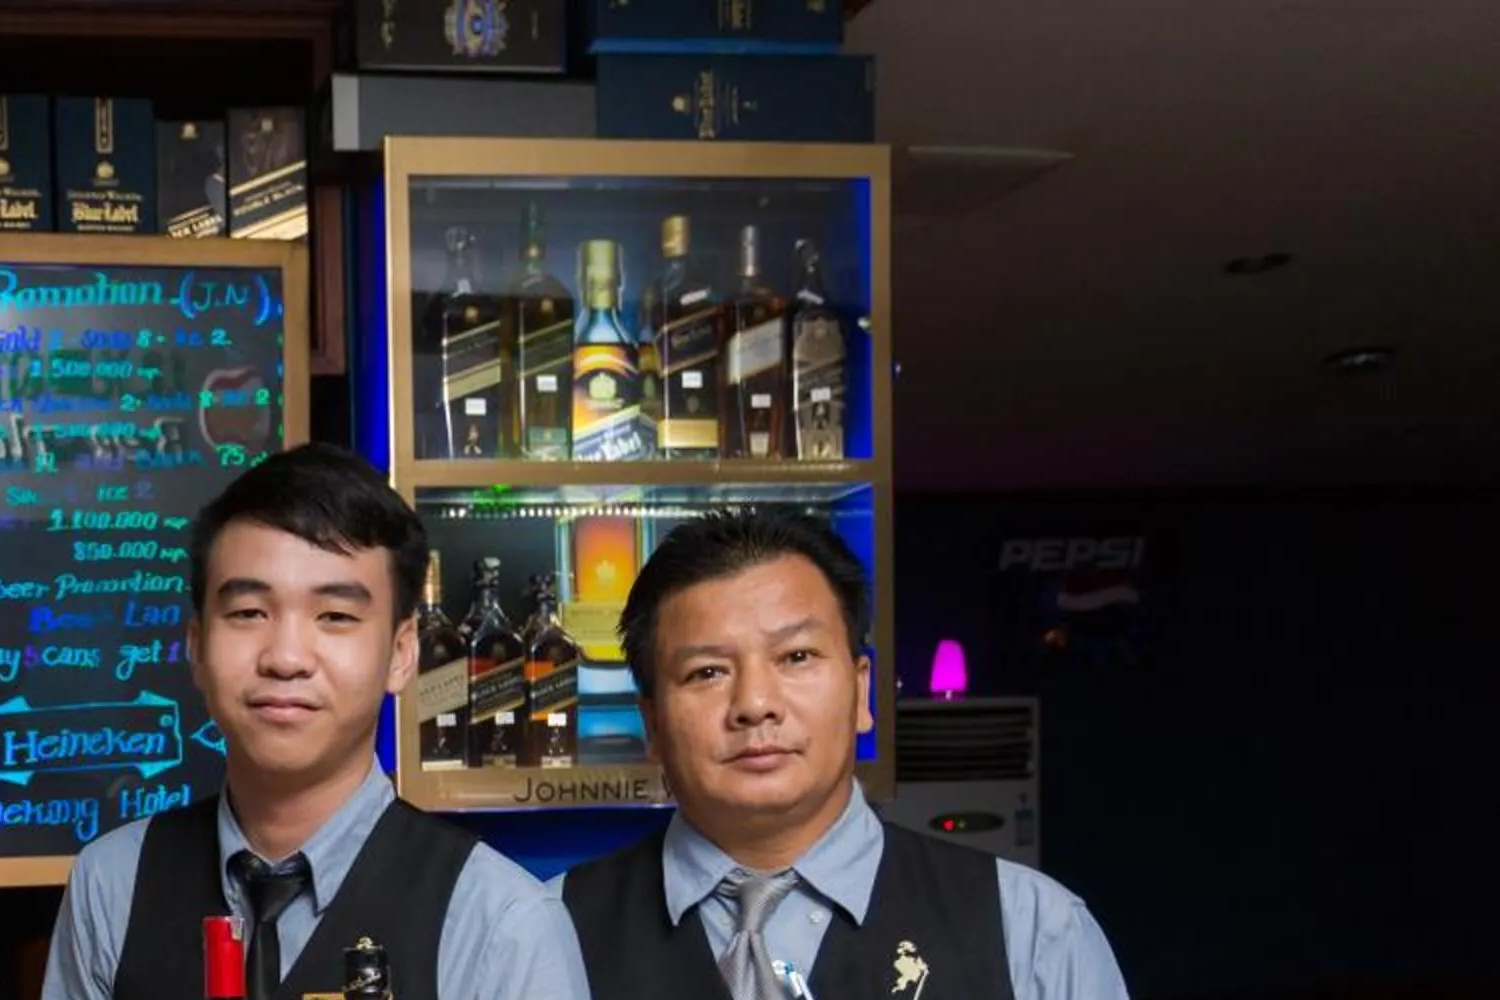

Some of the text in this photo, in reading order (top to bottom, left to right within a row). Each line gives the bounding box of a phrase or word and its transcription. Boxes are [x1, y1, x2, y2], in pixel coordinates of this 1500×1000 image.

[996, 536, 1149, 573] PEPSI
[115, 640, 163, 681] get
[3, 727, 166, 766] Heineken
[120, 783, 192, 818] Hotel
[514, 777, 649, 802] JOHNNIE
